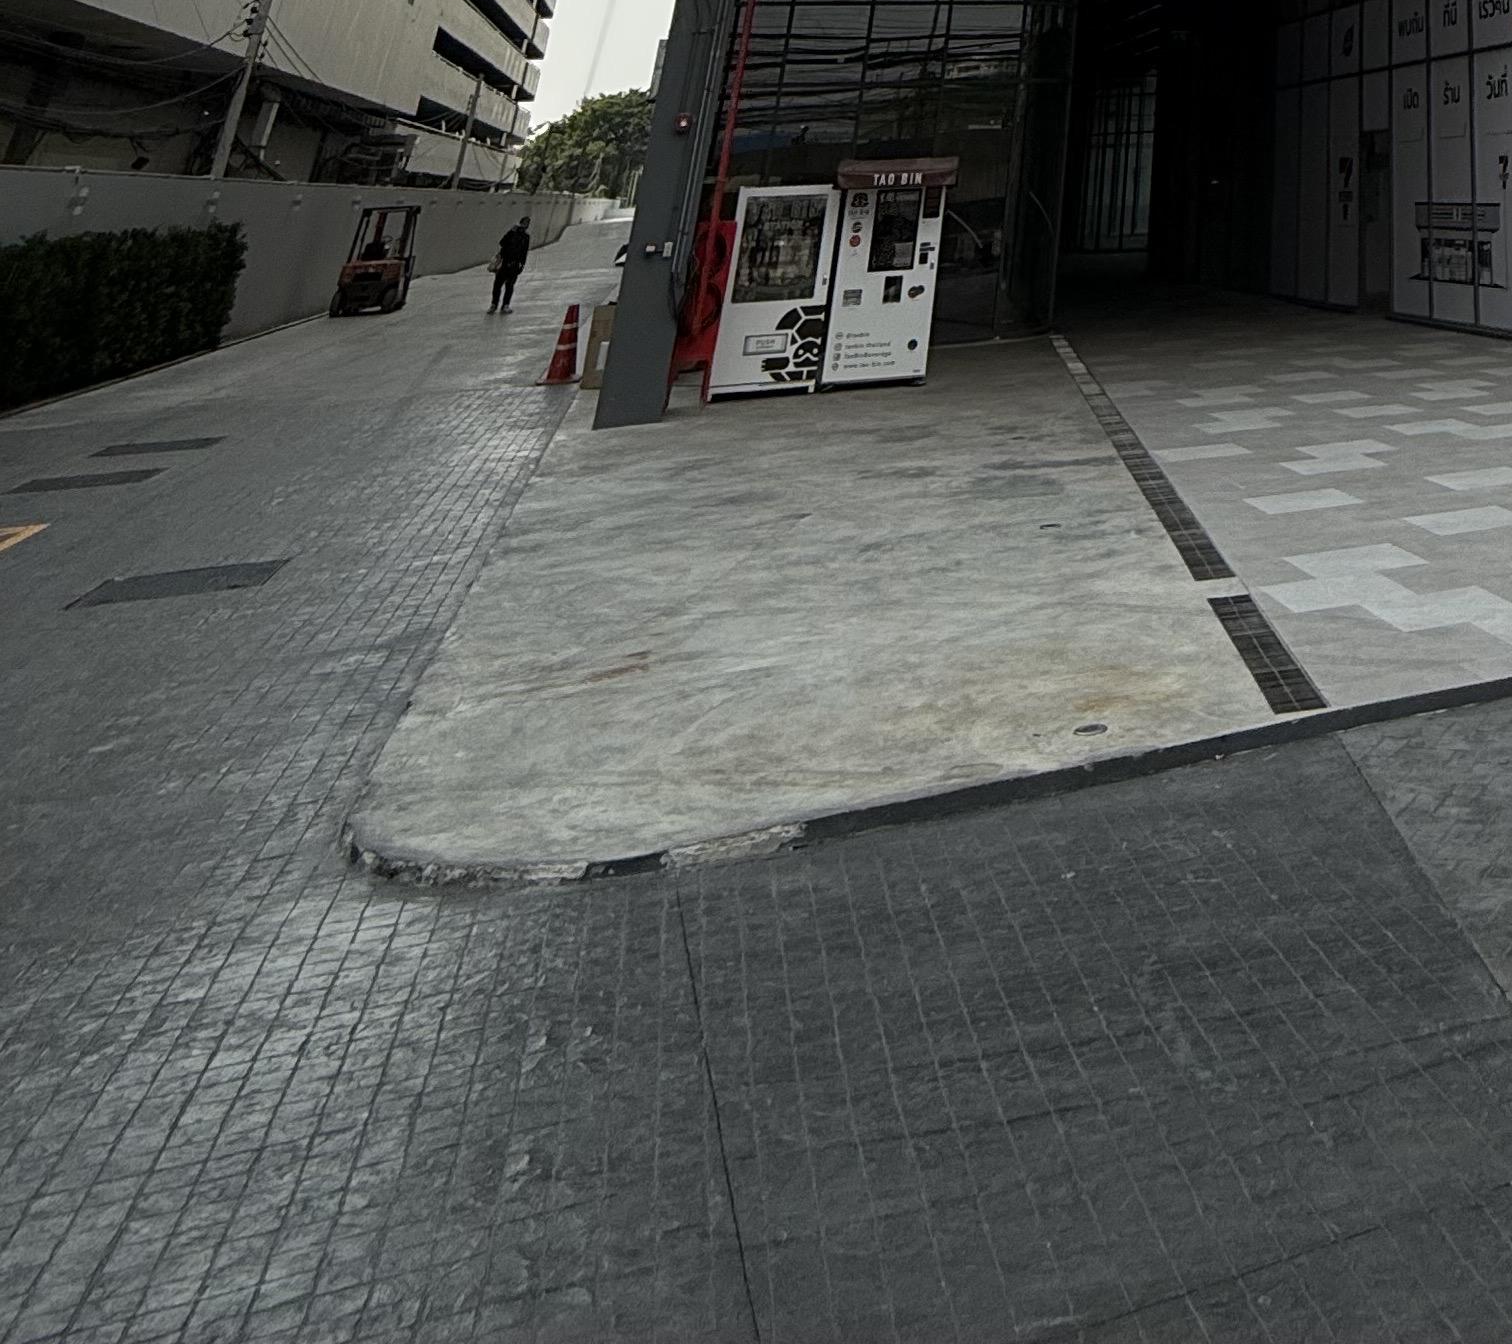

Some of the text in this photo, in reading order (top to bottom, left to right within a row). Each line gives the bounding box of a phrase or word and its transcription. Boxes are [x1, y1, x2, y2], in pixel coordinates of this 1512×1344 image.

[1443, 80, 1461, 105] ร้าน
[873, 172, 923, 186] TAO BIN
